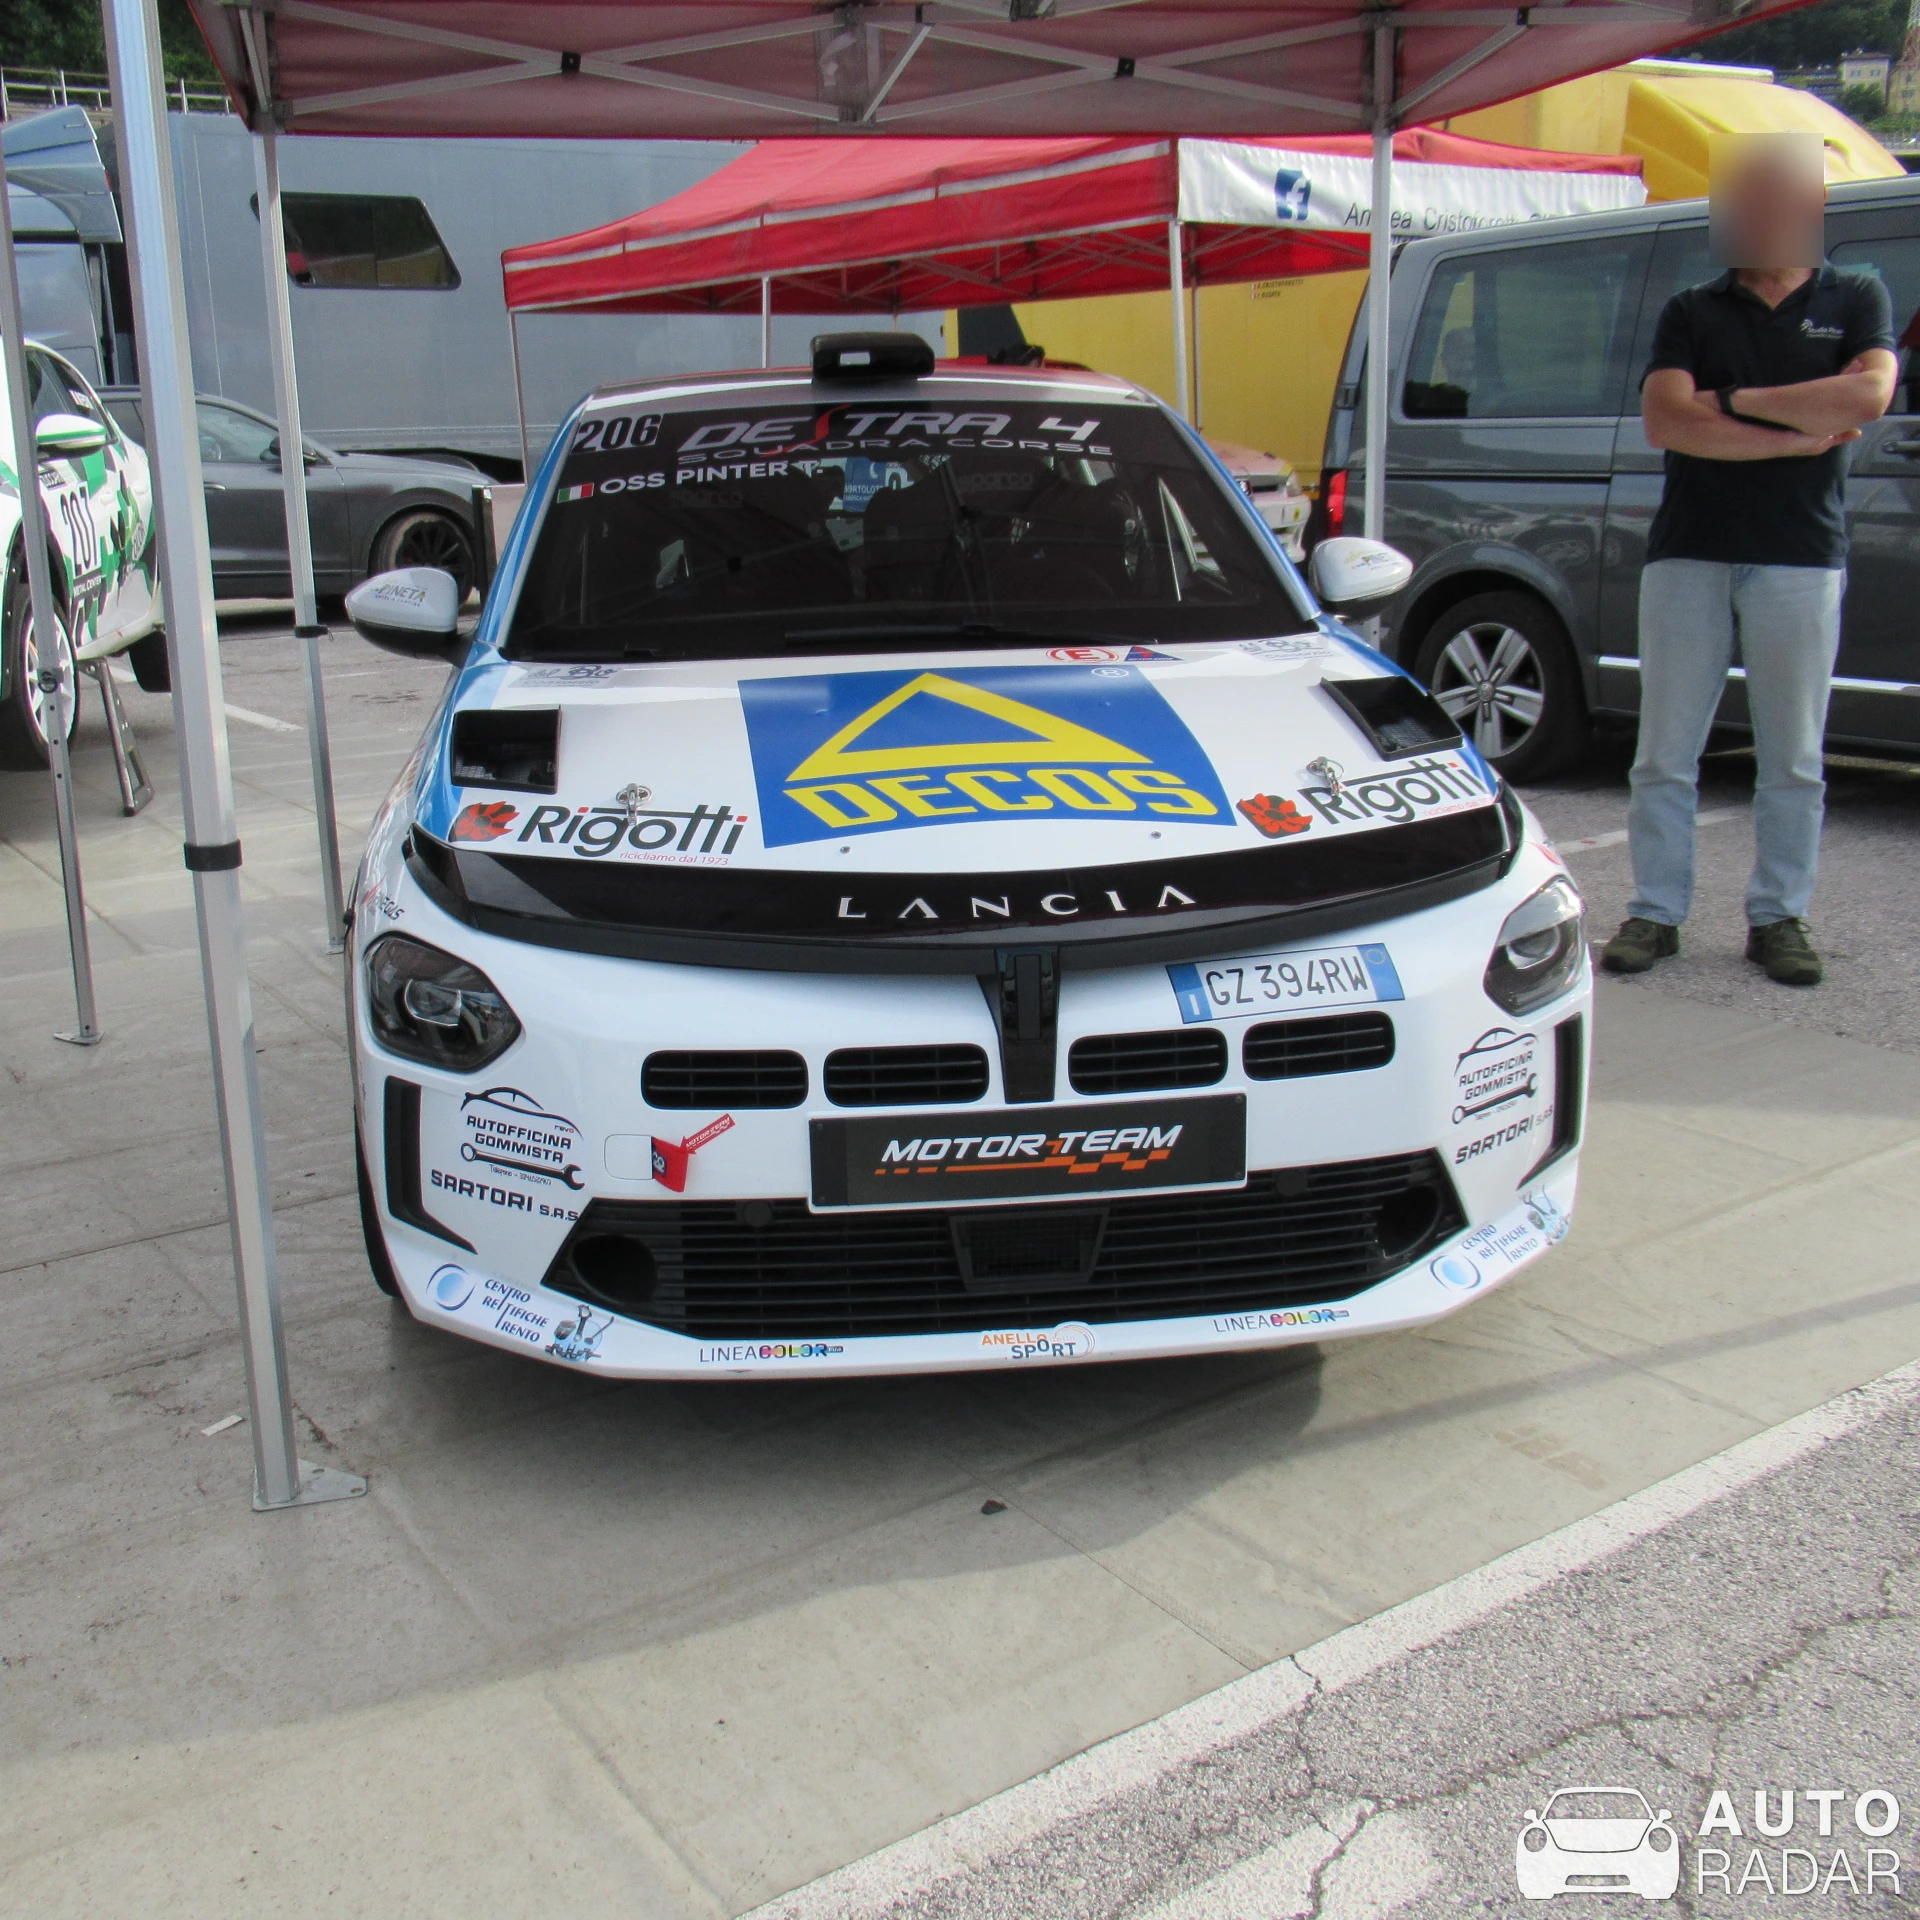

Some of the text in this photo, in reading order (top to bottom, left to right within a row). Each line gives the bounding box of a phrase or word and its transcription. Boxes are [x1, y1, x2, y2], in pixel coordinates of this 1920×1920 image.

[1343, 201, 1413, 229] Anea
[571, 413, 662, 454] 206
[1038, 416, 1100, 442] 4
[678, 437, 1113, 466] SQUADRA CORSE
[600, 472, 666, 494] OSS
[676, 460, 788, 485] PINTER
[60, 486, 98, 577] 207
[378, 584, 426, 603] PINETA
[783, 768, 1218, 828] DECOS
[1297, 757, 1490, 824] Rigotti
[517, 803, 748, 857] Rigotti
[620, 851, 729, 866] ricicliamo dal 1973
[838, 885, 1197, 920] LANCIA
[1205, 955, 1369, 1006] GZ 394RW
[1458, 1050, 1534, 1088] AUTOFFICINA
[1465, 1067, 1528, 1101] GOMMISTA
[466, 1114, 572, 1150] AUTOFFICINA
[474, 1131, 564, 1164] GOMMISTA
[881, 1124, 1183, 1163] MOTOR TEAM
[1455, 1114, 1534, 1165] SARTORI
[430, 1168, 533, 1212] SARTORI
[1461, 1224, 1498, 1251] CENTRO
[485, 1279, 531, 1304] CENTRO
[1213, 1308, 1336, 1333] LINEACOLOR
[700, 1343, 828, 1363] LINEACOLOR
[1011, 1338, 1077, 1359] SPORT
